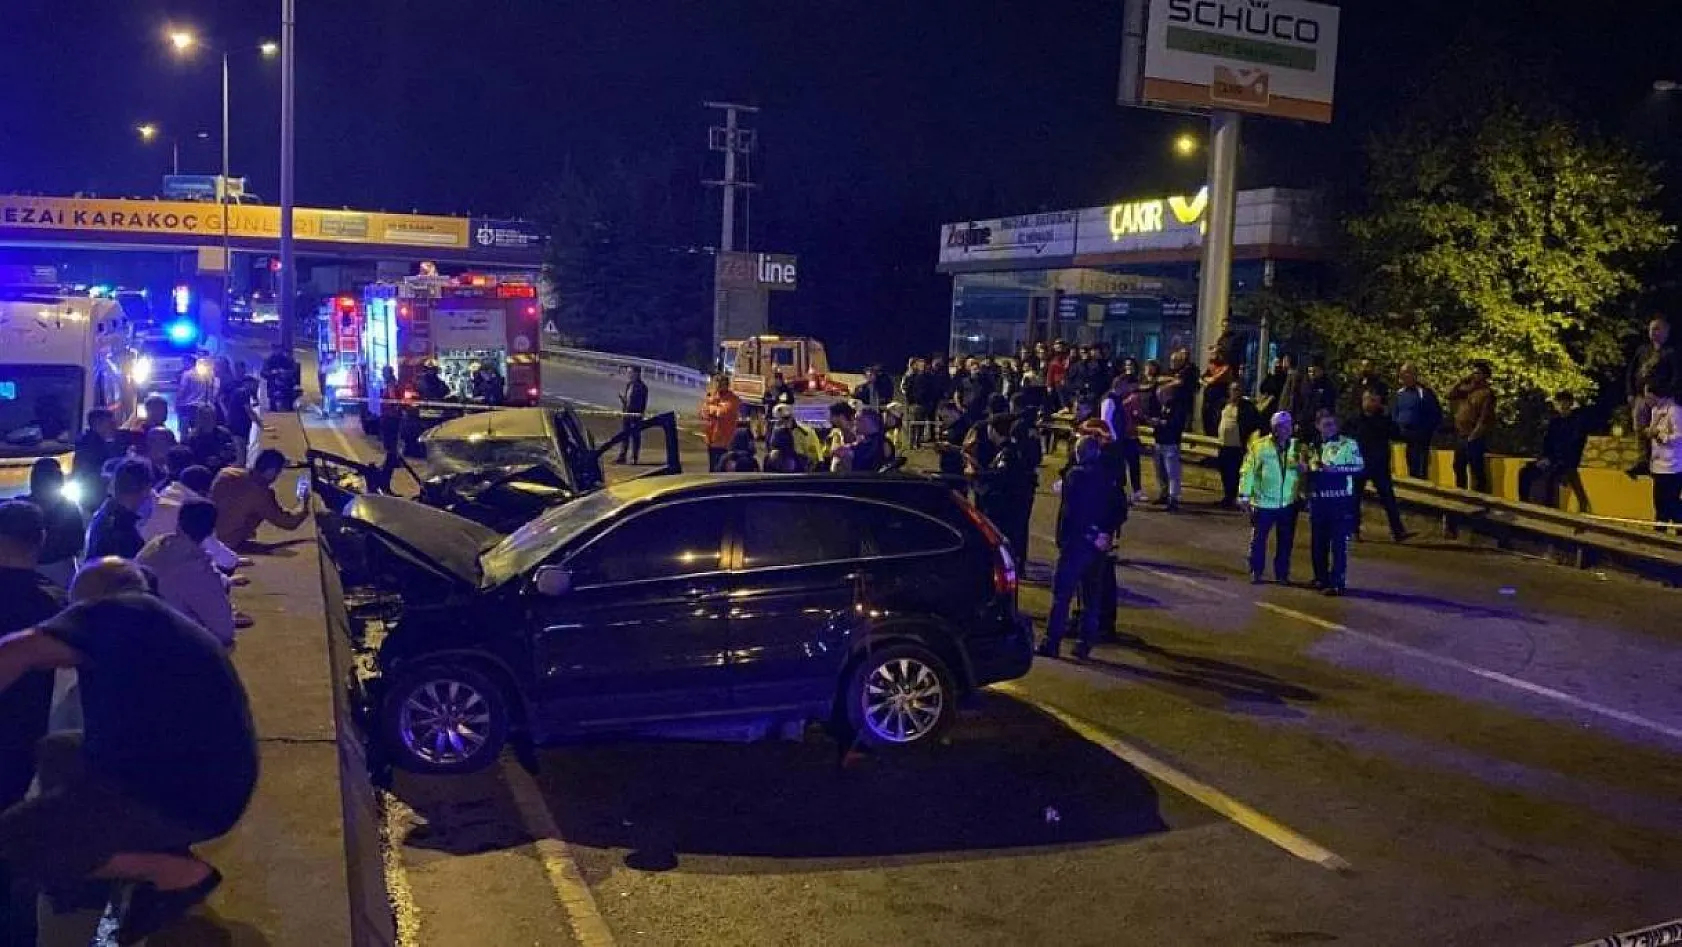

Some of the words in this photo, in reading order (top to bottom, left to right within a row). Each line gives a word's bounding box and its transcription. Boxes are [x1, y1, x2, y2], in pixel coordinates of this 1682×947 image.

[1168, 0, 1320, 44] SCHÜCO
[73, 209, 199, 231] KARAKOÇ
[1110, 200, 1163, 242] ÇAKIR
